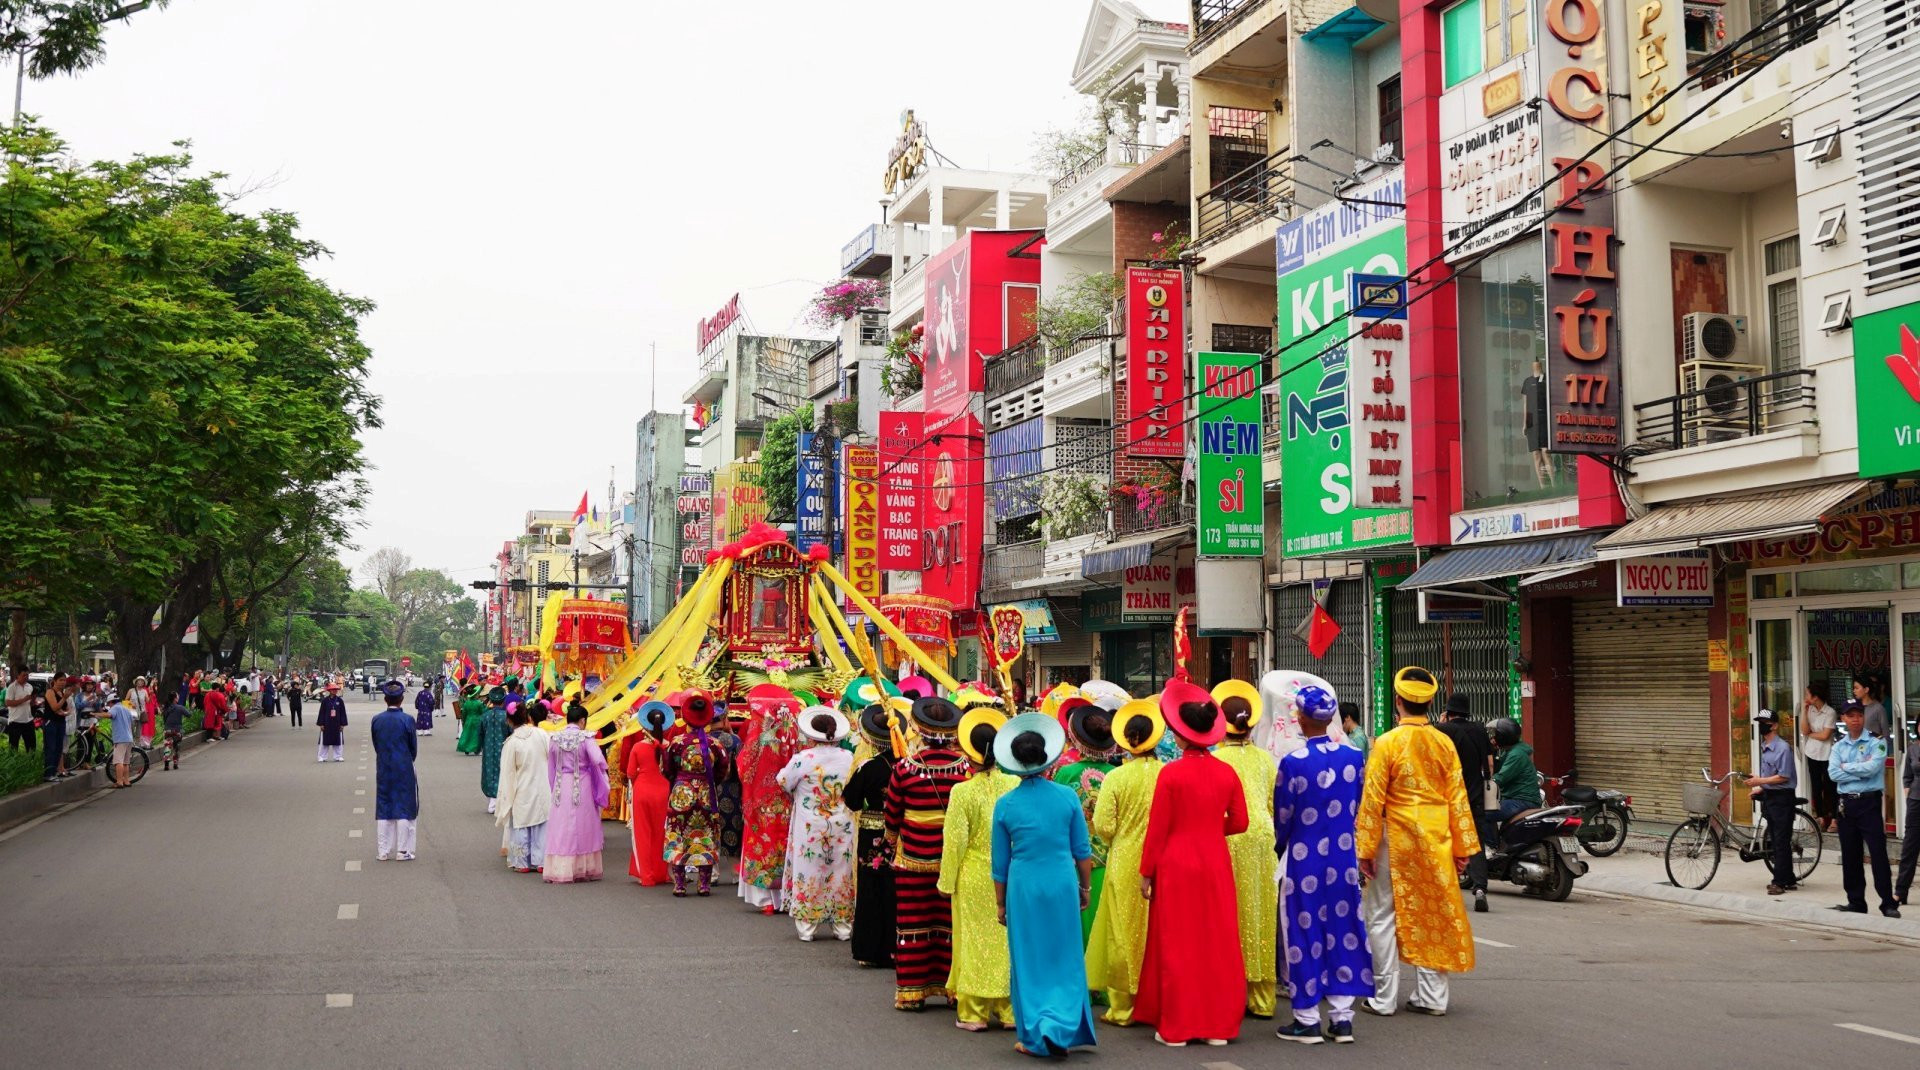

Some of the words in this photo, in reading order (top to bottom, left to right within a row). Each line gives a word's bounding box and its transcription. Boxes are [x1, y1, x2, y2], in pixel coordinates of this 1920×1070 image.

[1637, 0, 1668, 125] PHÚ
[1489, 124, 1504, 143] DỆT
[1506, 115, 1525, 135] MAY
[1306, 211, 1336, 256] NỆM
[1340, 192, 1369, 239] VIỆT
[1374, 178, 1403, 224] HÀN
[1550, 157, 1616, 361] PHÚ
[1372, 350, 1393, 367] TY
[1204, 364, 1256, 399] KHO
[1564, 373, 1610, 405] 177
[1362, 398, 1406, 421] PHẦN
[1202, 415, 1260, 463] NỆM
[1369, 429, 1400, 451] DỆT
[883, 461, 919, 474] TRUNG
[1368, 459, 1401, 476] MAY
[681, 475, 709, 491] Kính
[889, 477, 913, 490] TÂM
[1219, 468, 1244, 513] SỈ
[678, 497, 711, 516] QUANG
[853, 468, 876, 541] HOÀNG
[886, 492, 915, 507] VÀNG
[889, 512, 912, 525] BẠC
[883, 528, 918, 540] TRANG
[1205, 528, 1221, 544] 173
[889, 542, 912, 557] SỨC
[854, 547, 876, 592] ĐỨC
[1626, 564, 1673, 596] NGỌC
[1676, 560, 1709, 591] PHÚ
[1126, 587, 1171, 609] THÀNH
